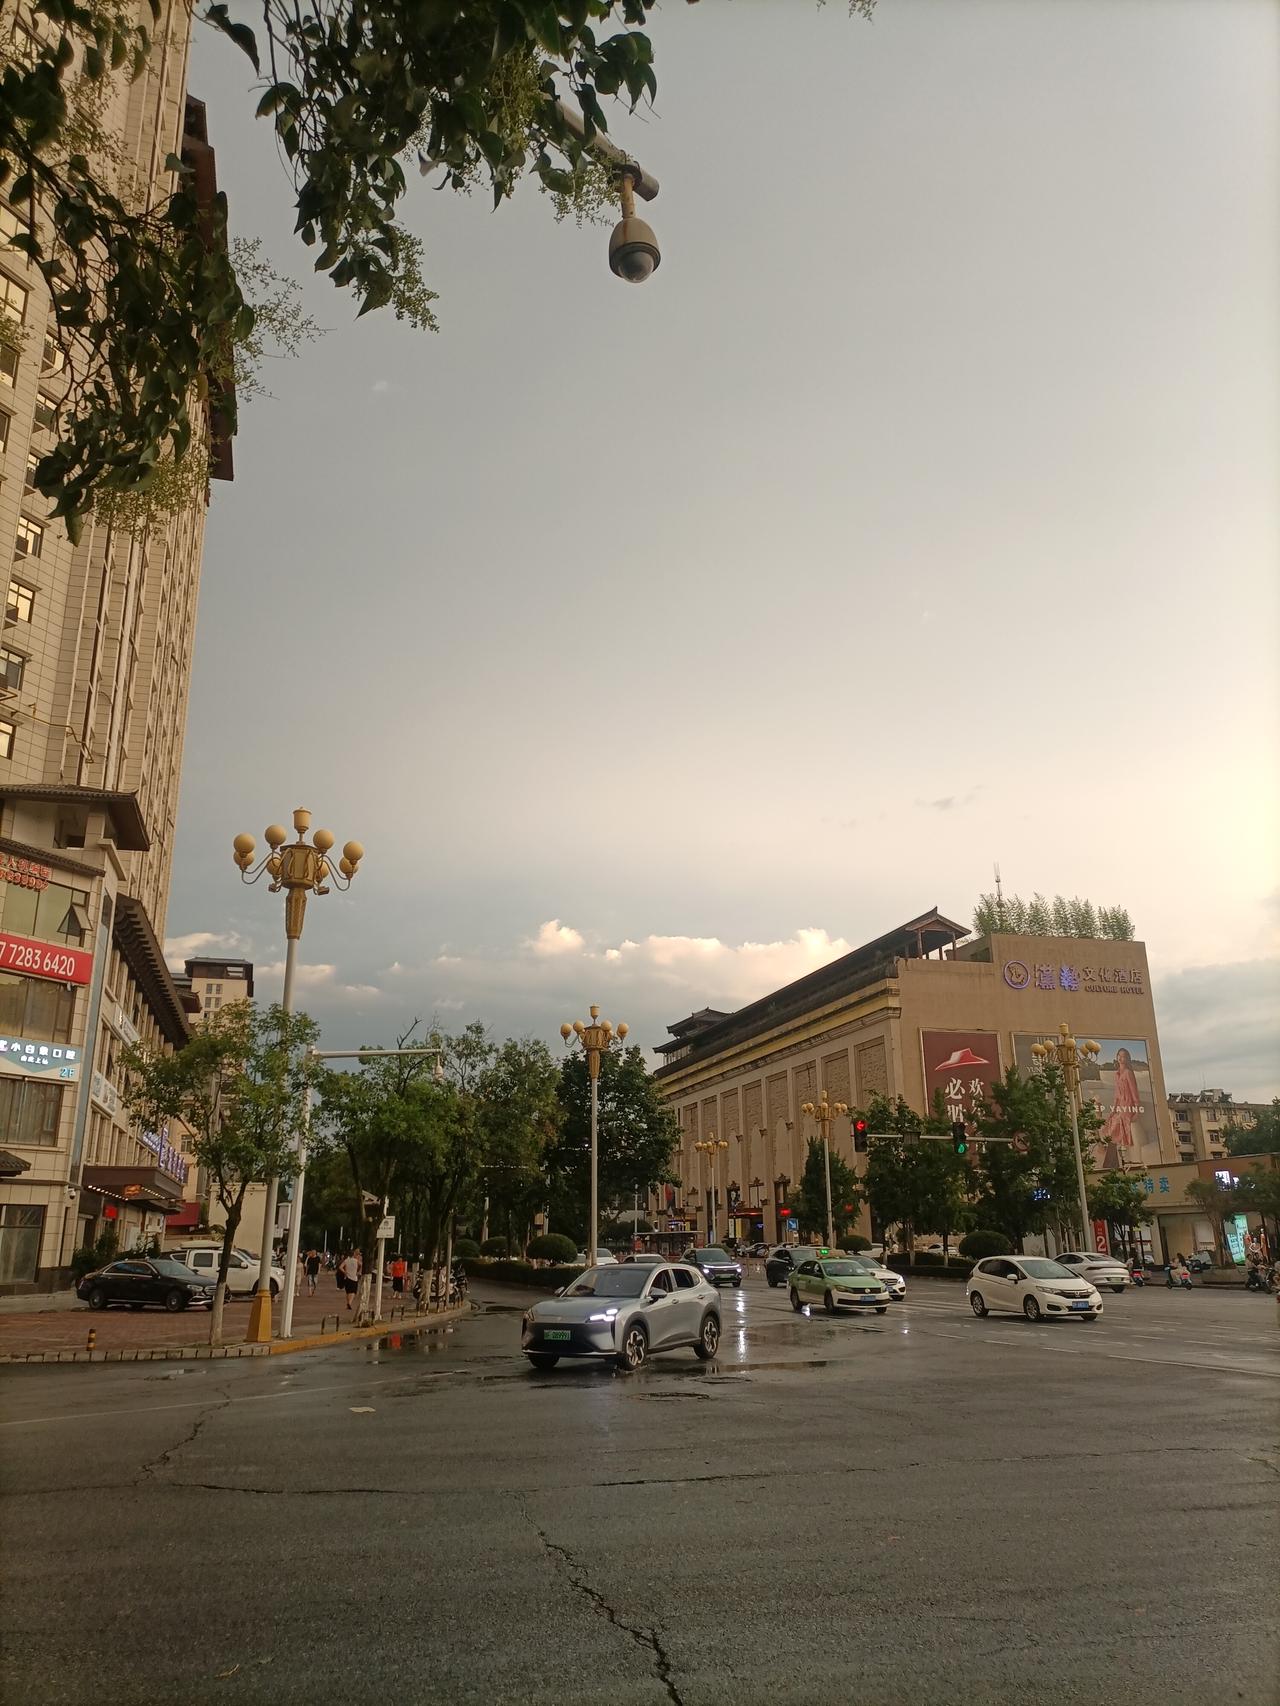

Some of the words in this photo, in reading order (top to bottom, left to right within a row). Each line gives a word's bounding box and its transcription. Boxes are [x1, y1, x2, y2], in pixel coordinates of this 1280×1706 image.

[8, 943, 42, 970] 7283
[43, 952, 75, 977] 6420
[1109, 1105, 1145, 1113] YAYING
